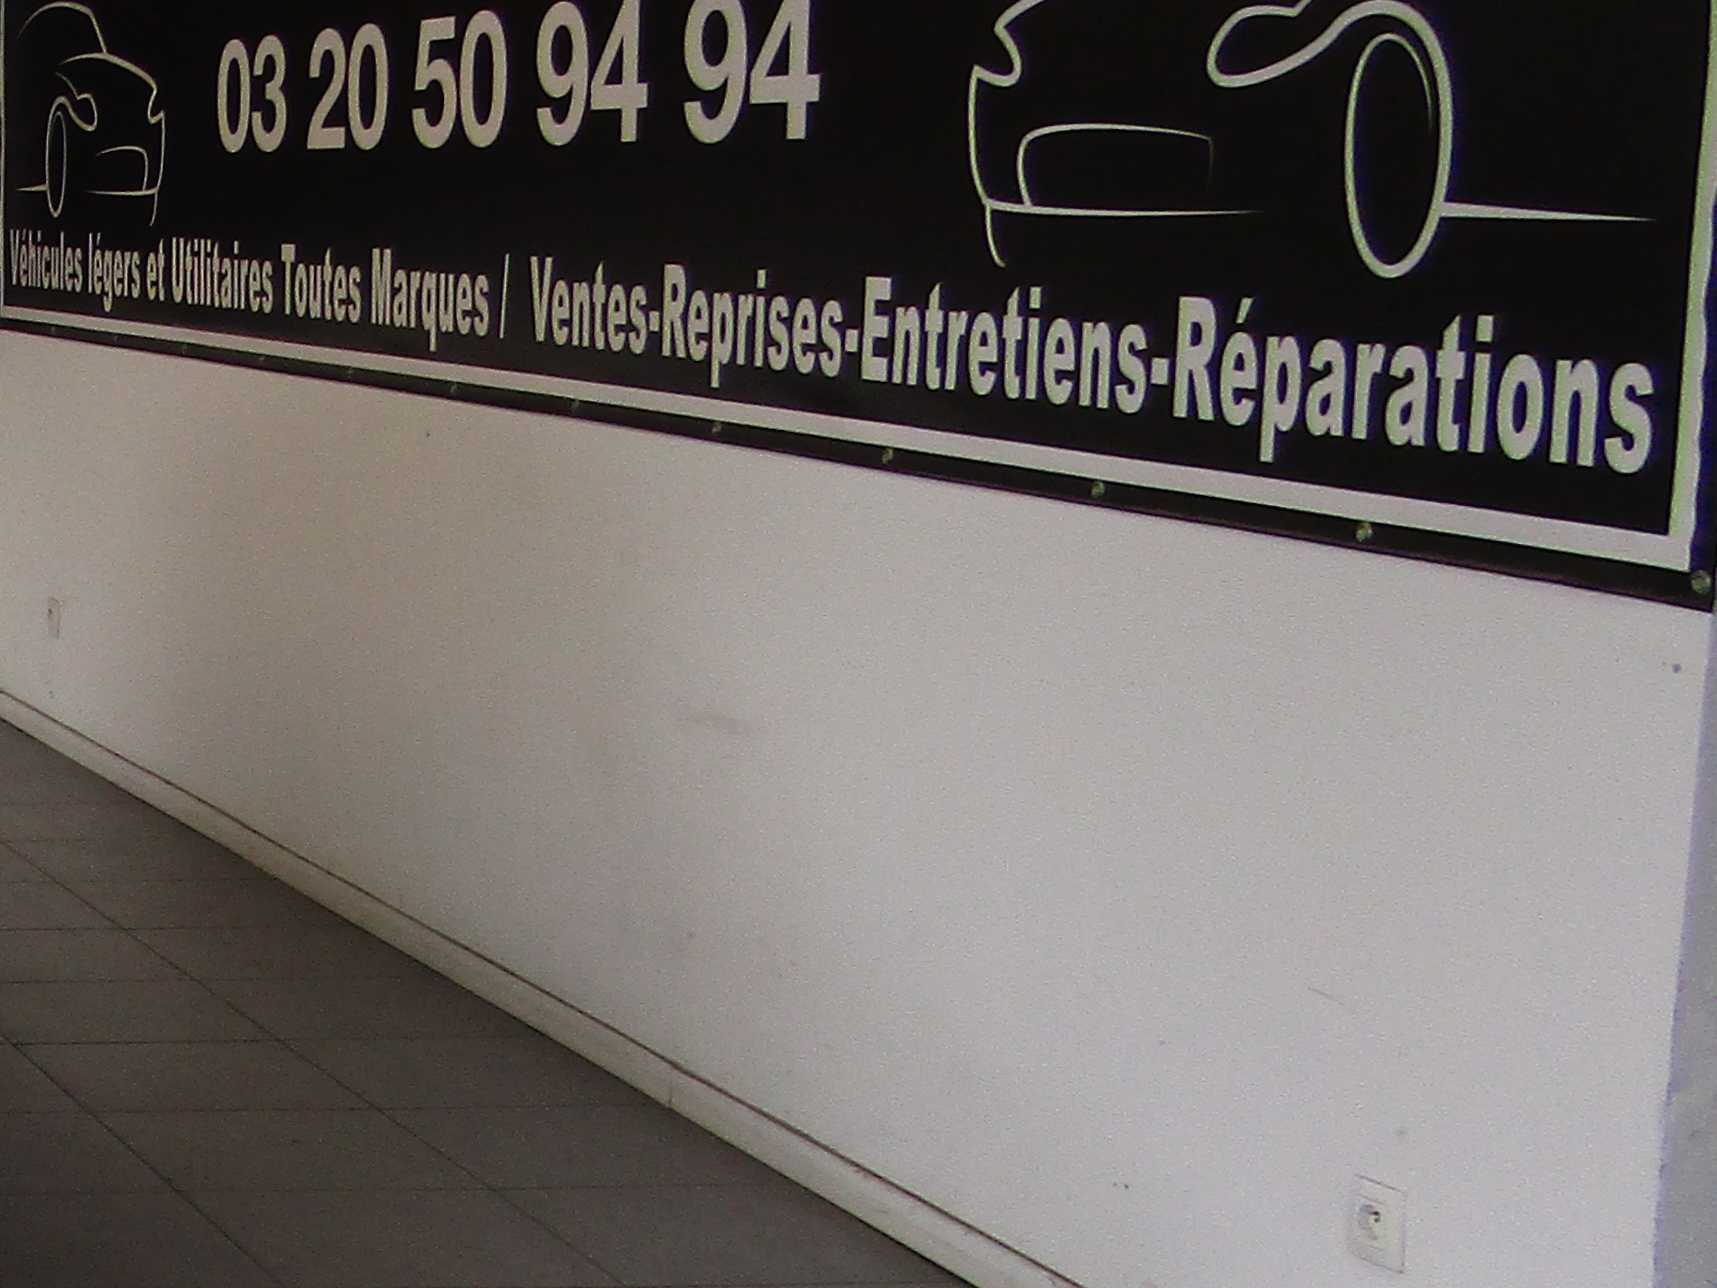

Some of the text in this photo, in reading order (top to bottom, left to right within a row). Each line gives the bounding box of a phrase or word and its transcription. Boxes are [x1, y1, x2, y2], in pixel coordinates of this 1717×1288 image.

[217, 35, 287, 153] 03
[306, 23, 389, 151] 20
[411, 9, 508, 149] 50
[10, 228, 83, 293] Véhicules
[89, 232, 140, 313] légers
[146, 239, 165, 302] et
[172, 236, 273, 314] Utilitaires
[280, 243, 362, 323] Toutes
[370, 247, 490, 352] Marques
